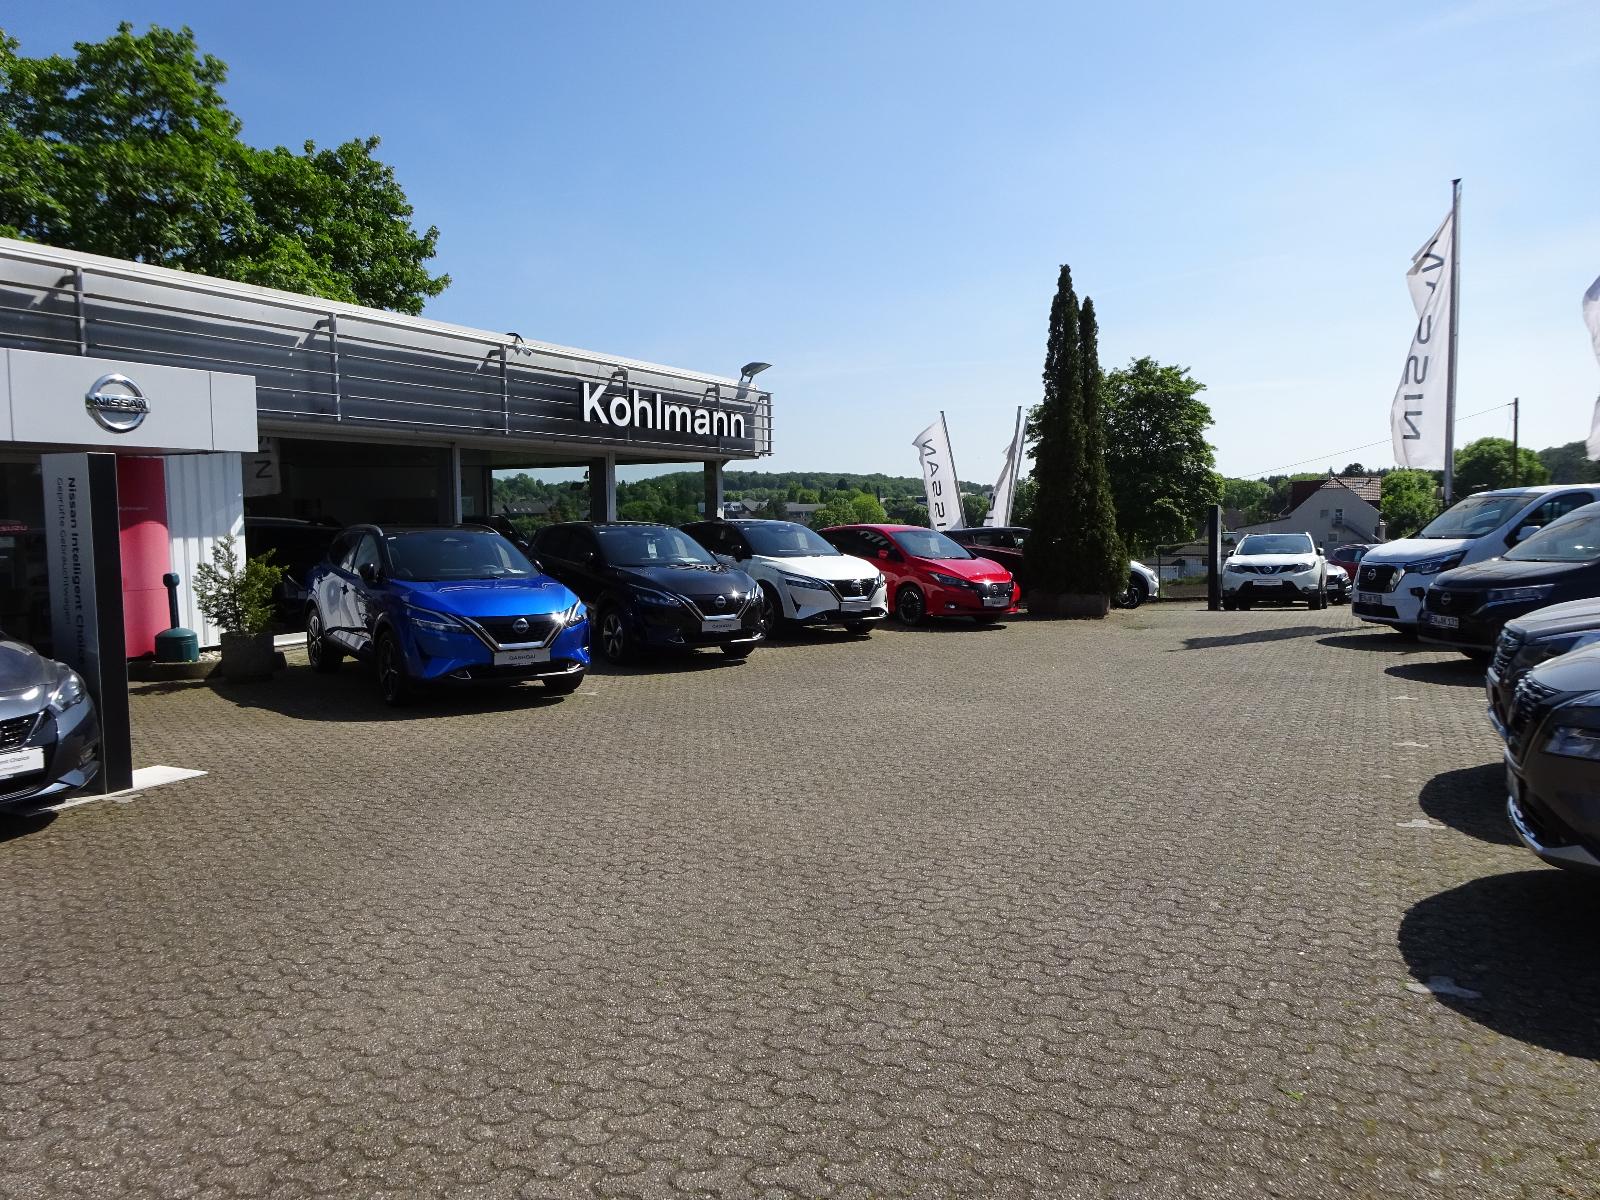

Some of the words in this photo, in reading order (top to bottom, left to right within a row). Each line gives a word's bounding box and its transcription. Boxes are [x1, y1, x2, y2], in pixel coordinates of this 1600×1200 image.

[94, 396, 147, 410] NISSAN
[583, 382, 745, 438] Kohlmann
[56, 477, 66, 527] Geprüfte
[68, 477, 77, 528] Nissan
[71, 533, 82, 611] Intelligent
